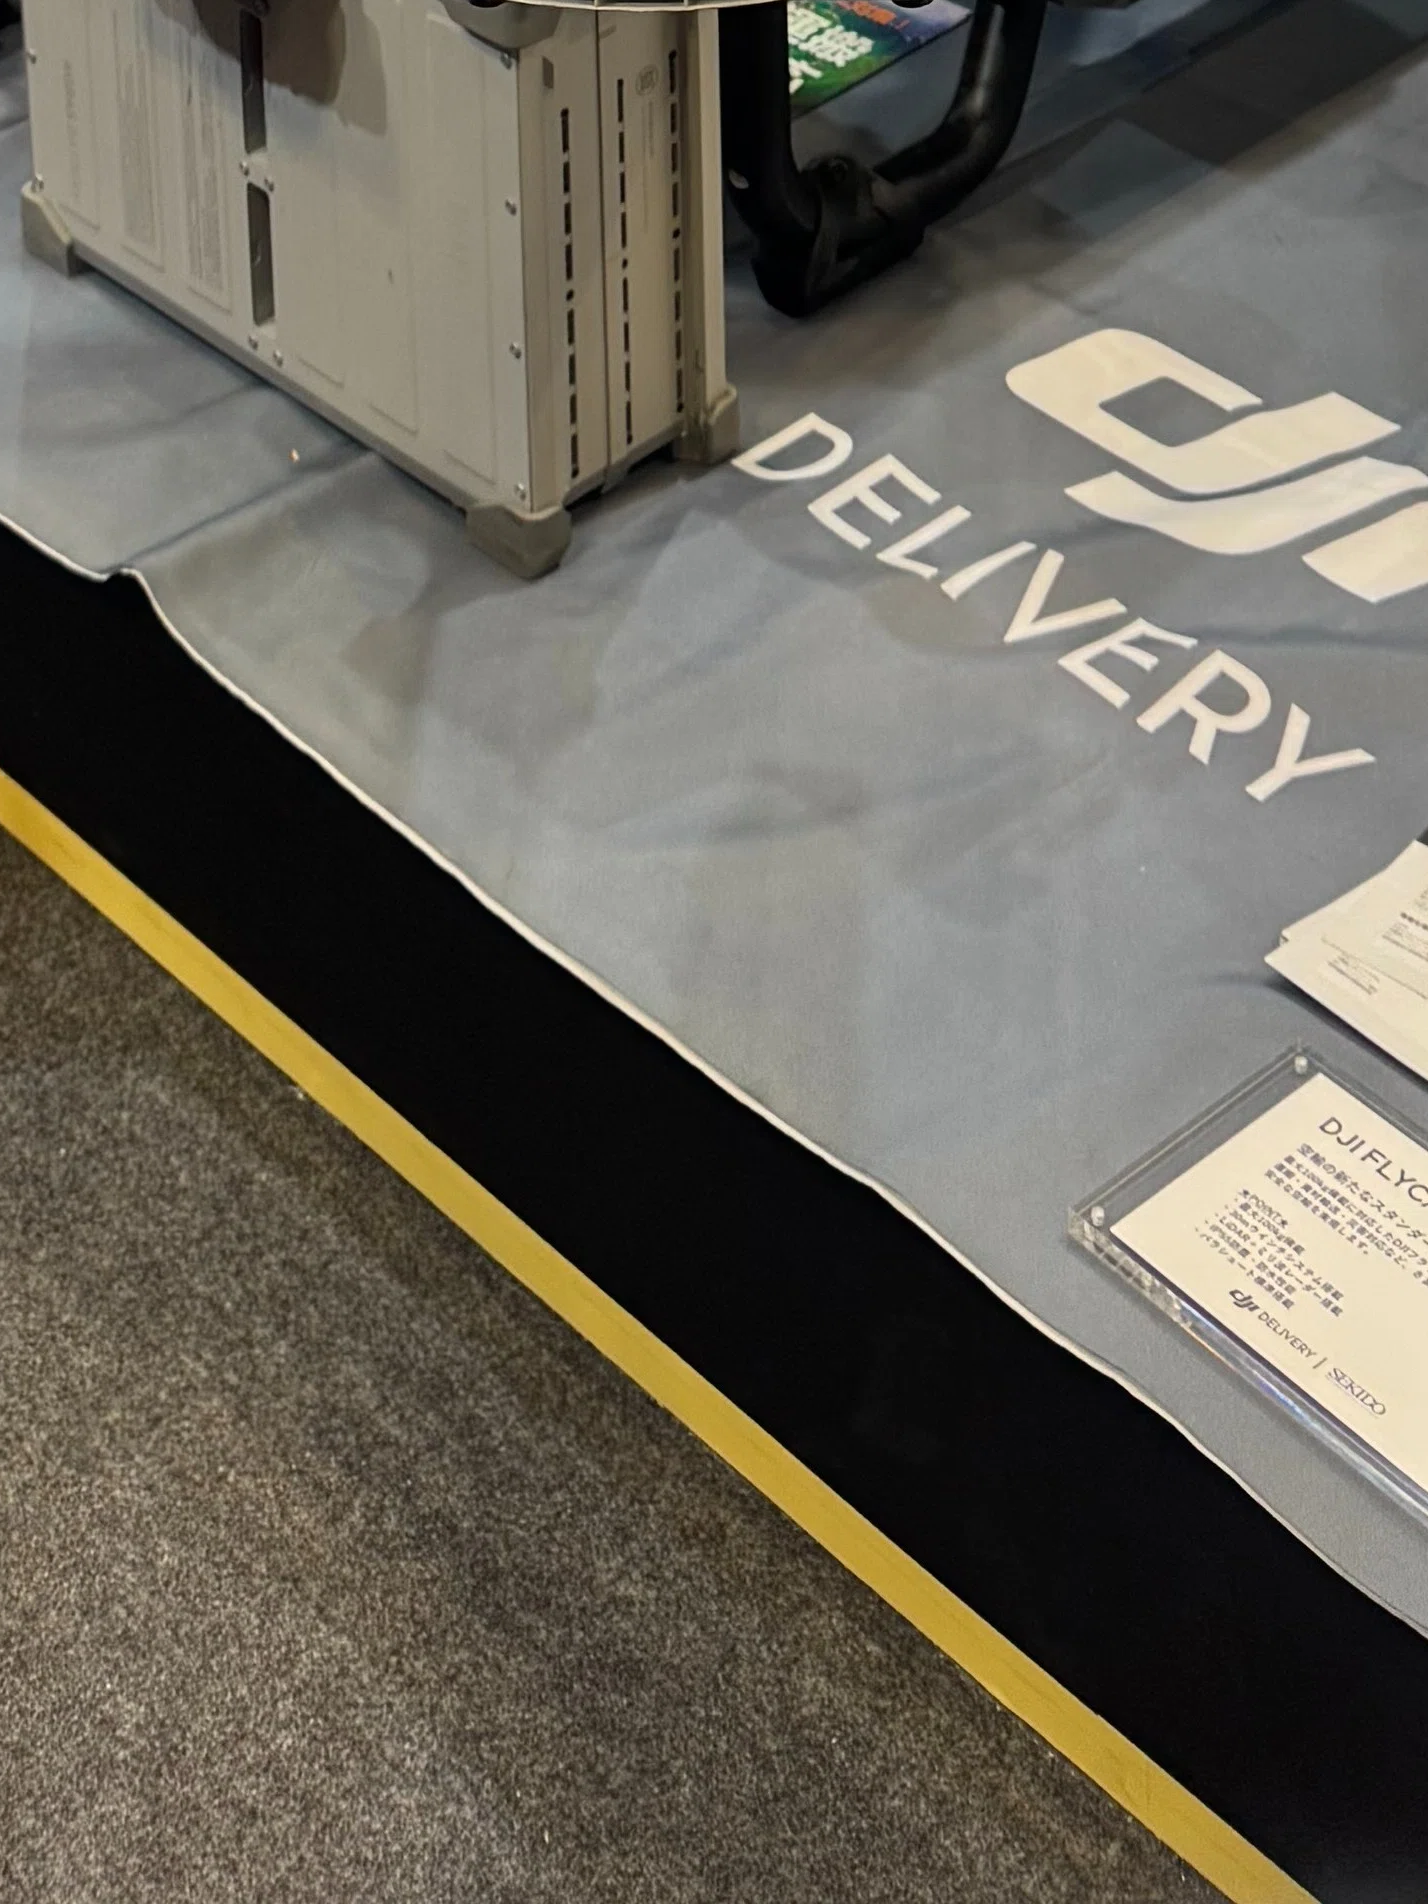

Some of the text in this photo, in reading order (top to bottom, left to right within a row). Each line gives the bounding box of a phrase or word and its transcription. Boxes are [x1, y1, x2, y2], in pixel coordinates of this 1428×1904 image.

[731, 411, 1376, 802] DELIVERY
[1316, 1115, 1367, 1154] DJI
[1254, 1309, 1318, 1361] DELIVERY
[1325, 1365, 1389, 1418] SEKIDO
